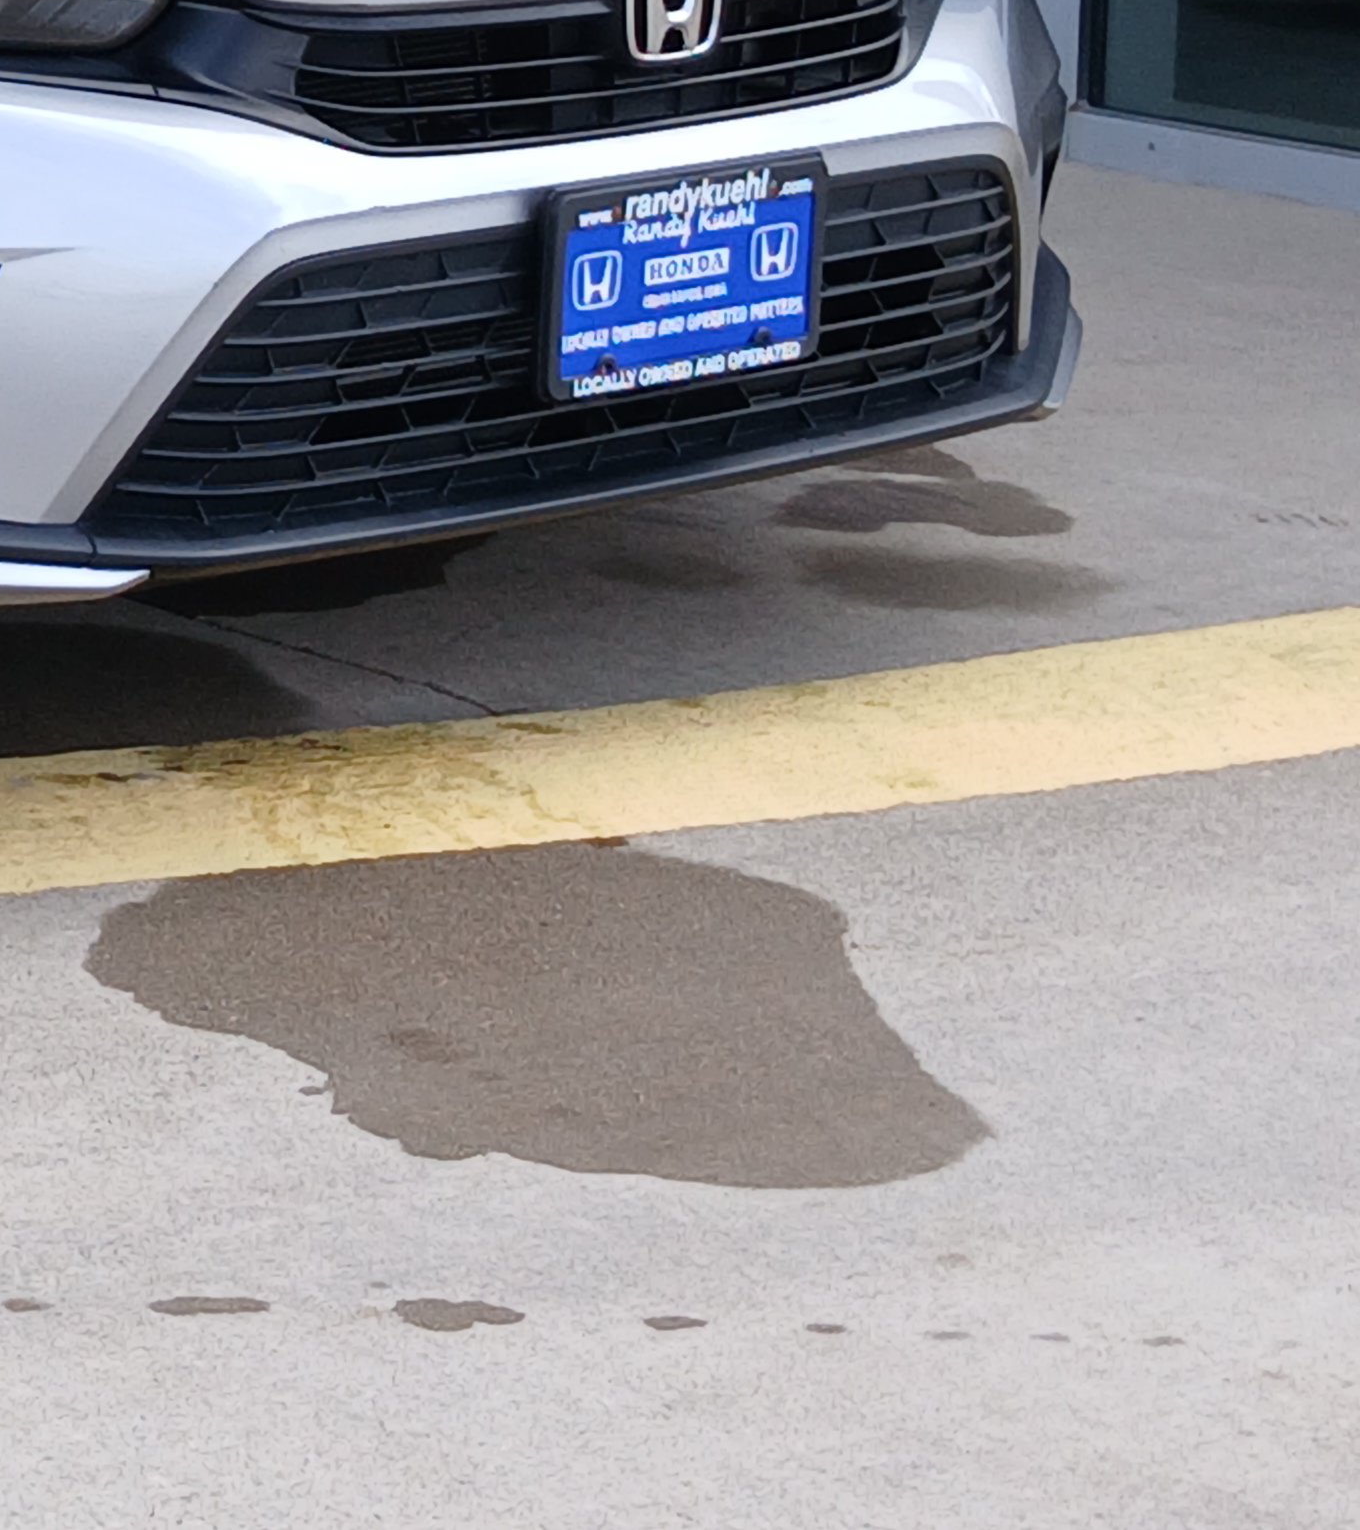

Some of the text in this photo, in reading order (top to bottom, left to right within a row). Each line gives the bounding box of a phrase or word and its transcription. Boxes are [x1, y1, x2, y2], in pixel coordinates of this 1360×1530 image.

[625, 168, 769, 220] randykuehl
[622, 215, 692, 248] Randy
[649, 252, 726, 281] HONDA
[573, 341, 801, 398] LOCALLY OWNED AND OPERATED
